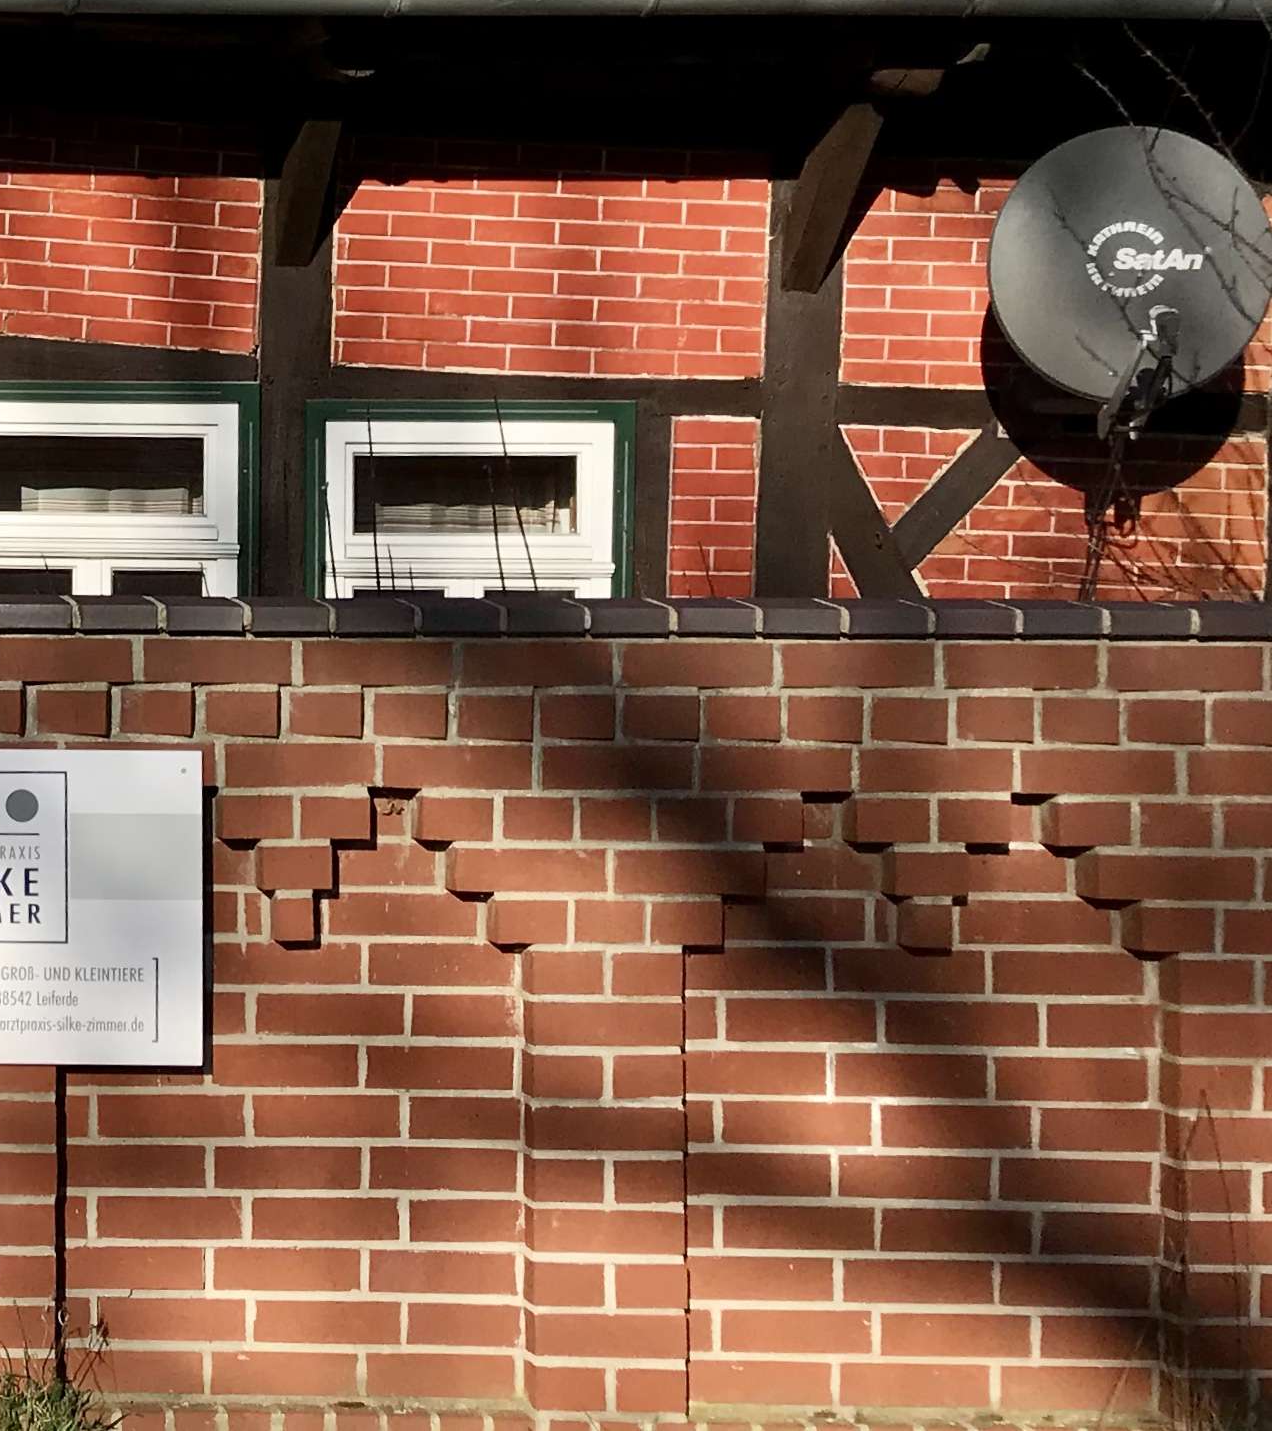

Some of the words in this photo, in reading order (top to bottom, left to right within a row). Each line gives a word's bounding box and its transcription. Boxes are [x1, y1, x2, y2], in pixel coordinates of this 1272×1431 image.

[1112, 246, 1204, 271] SatAn
[43, 966, 71, 982] UND
[74, 966, 145, 983] KLEINTIERE
[36, 989, 80, 1007] Leiferde
